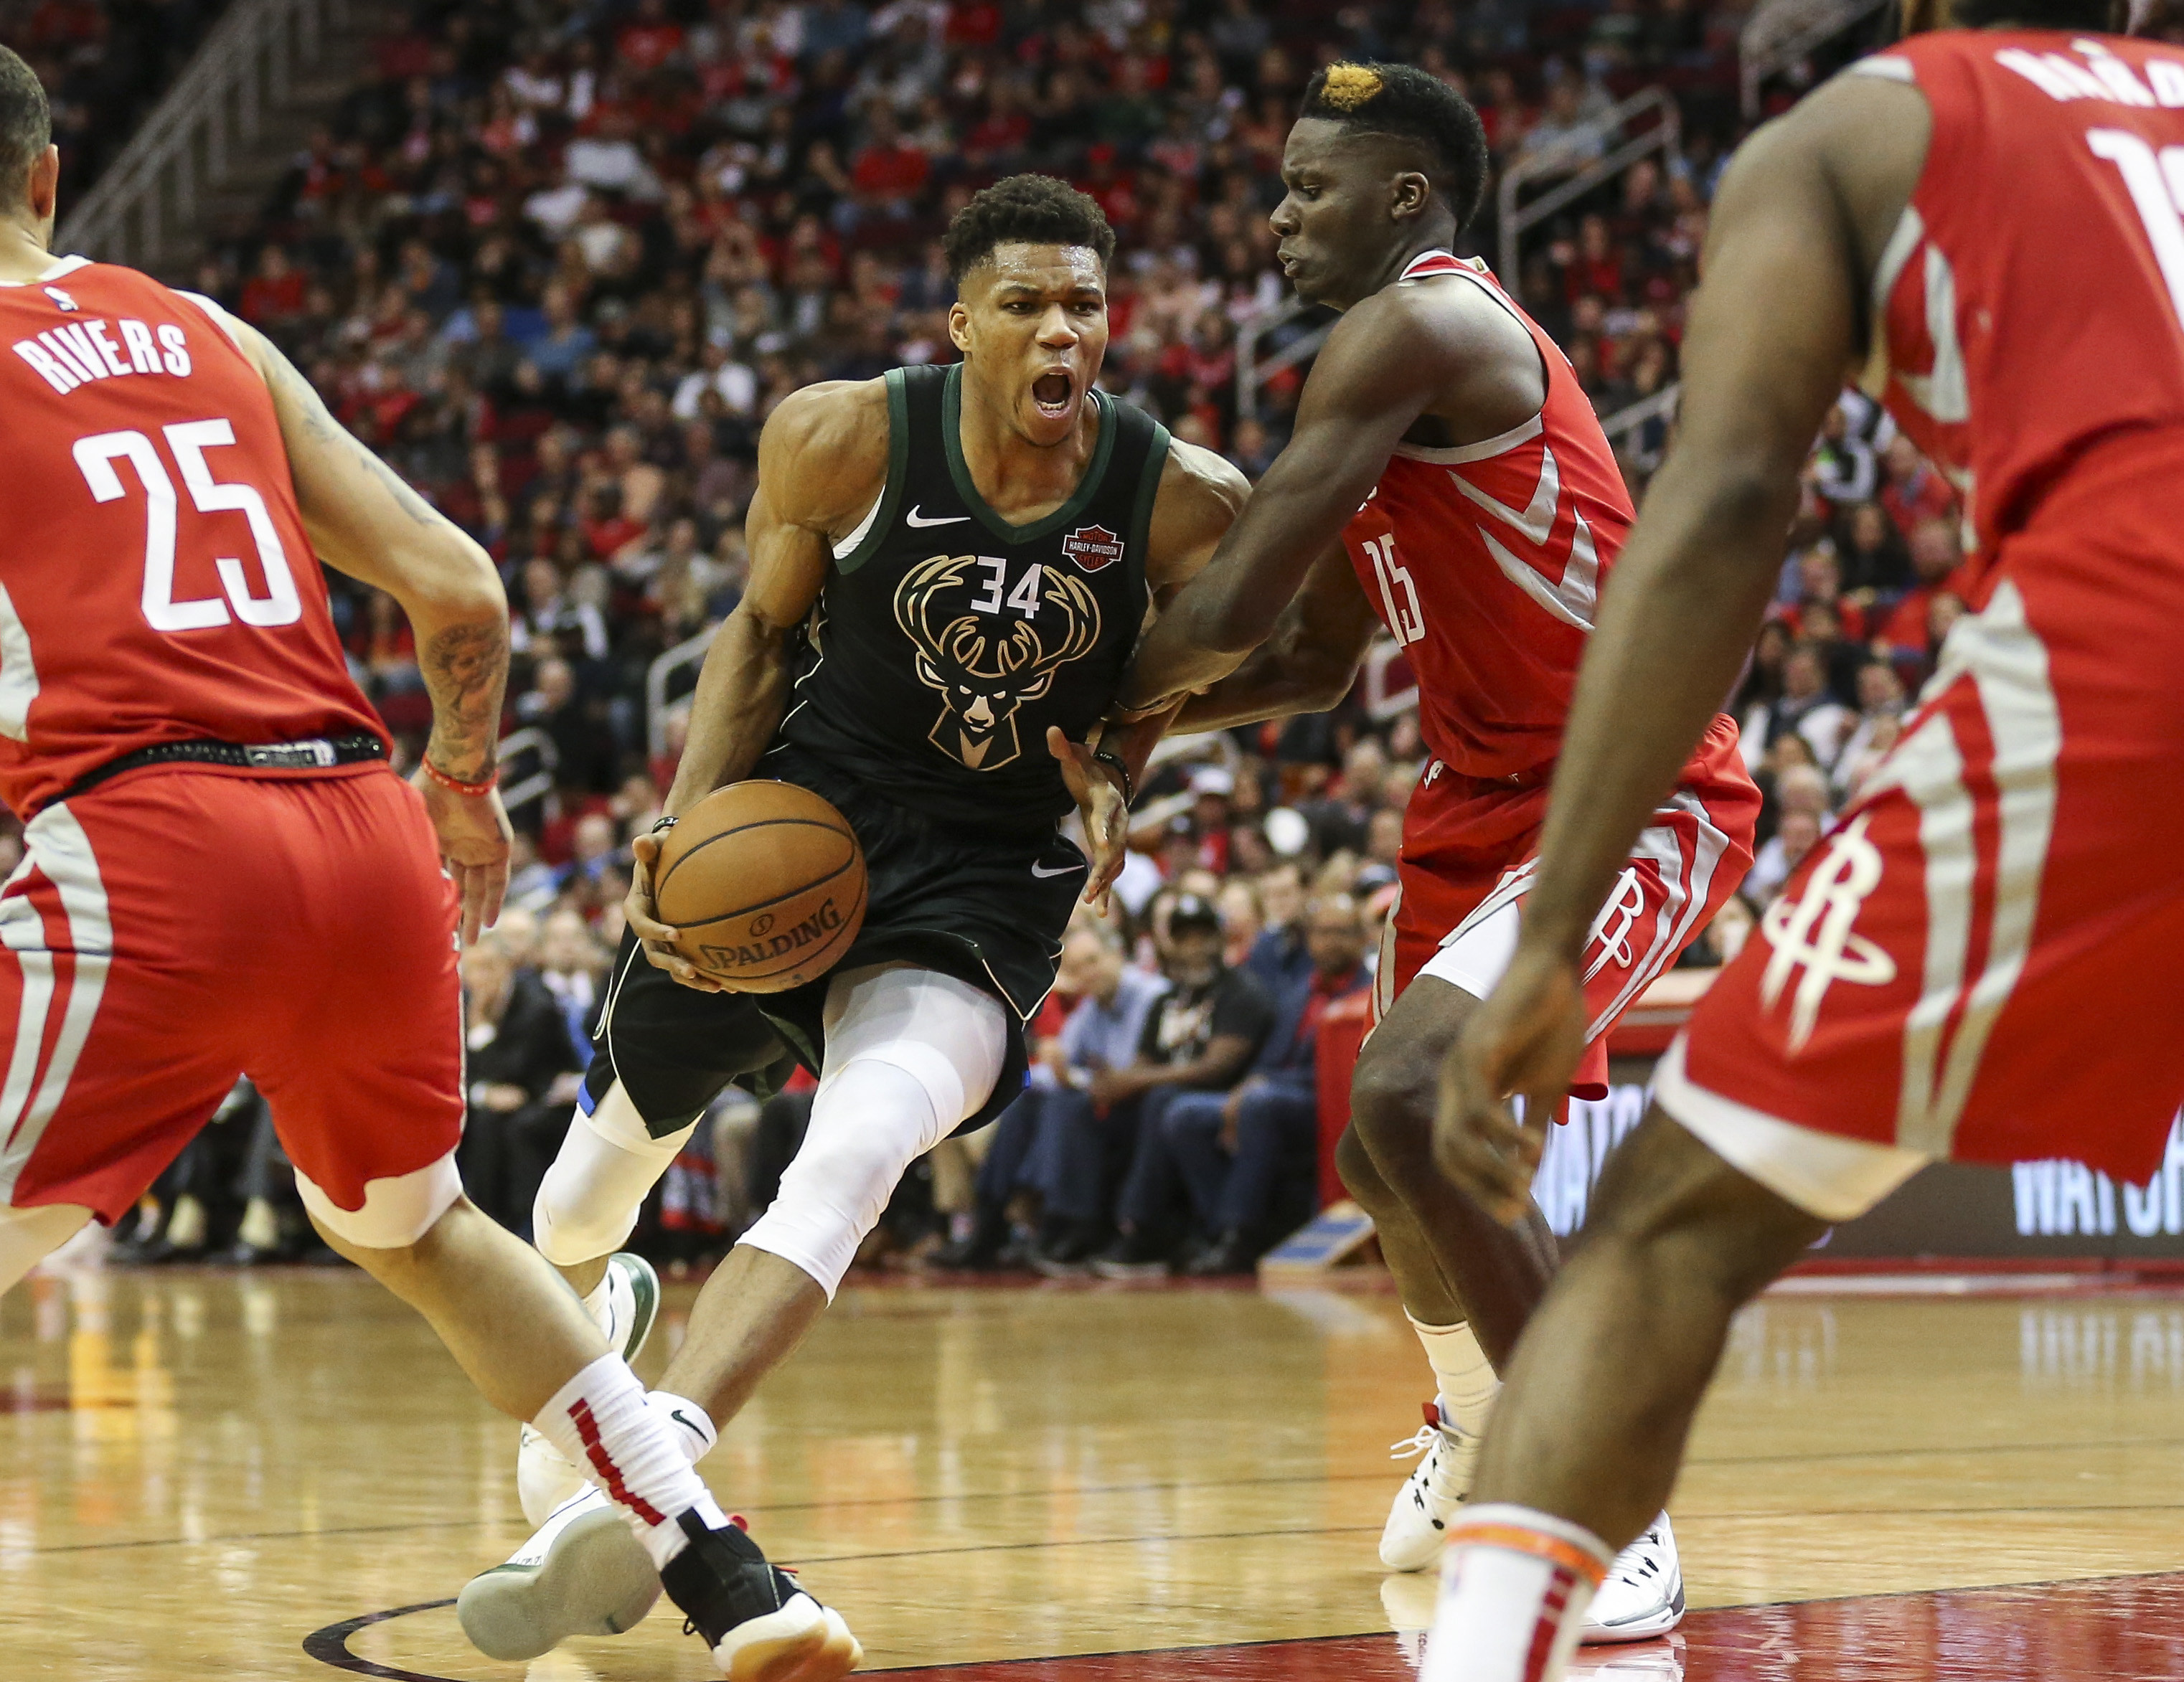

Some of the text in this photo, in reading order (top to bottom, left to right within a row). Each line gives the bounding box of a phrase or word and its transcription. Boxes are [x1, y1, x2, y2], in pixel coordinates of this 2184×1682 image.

[11, 319, 192, 395] RIVERS
[72, 417, 302, 631] 25
[1068, 541, 1118, 555] HARLEY-DAVIDSON
[971, 556, 1044, 619] 34
[1362, 533, 1426, 648] 15
[699, 898, 844, 970] SPALDING
